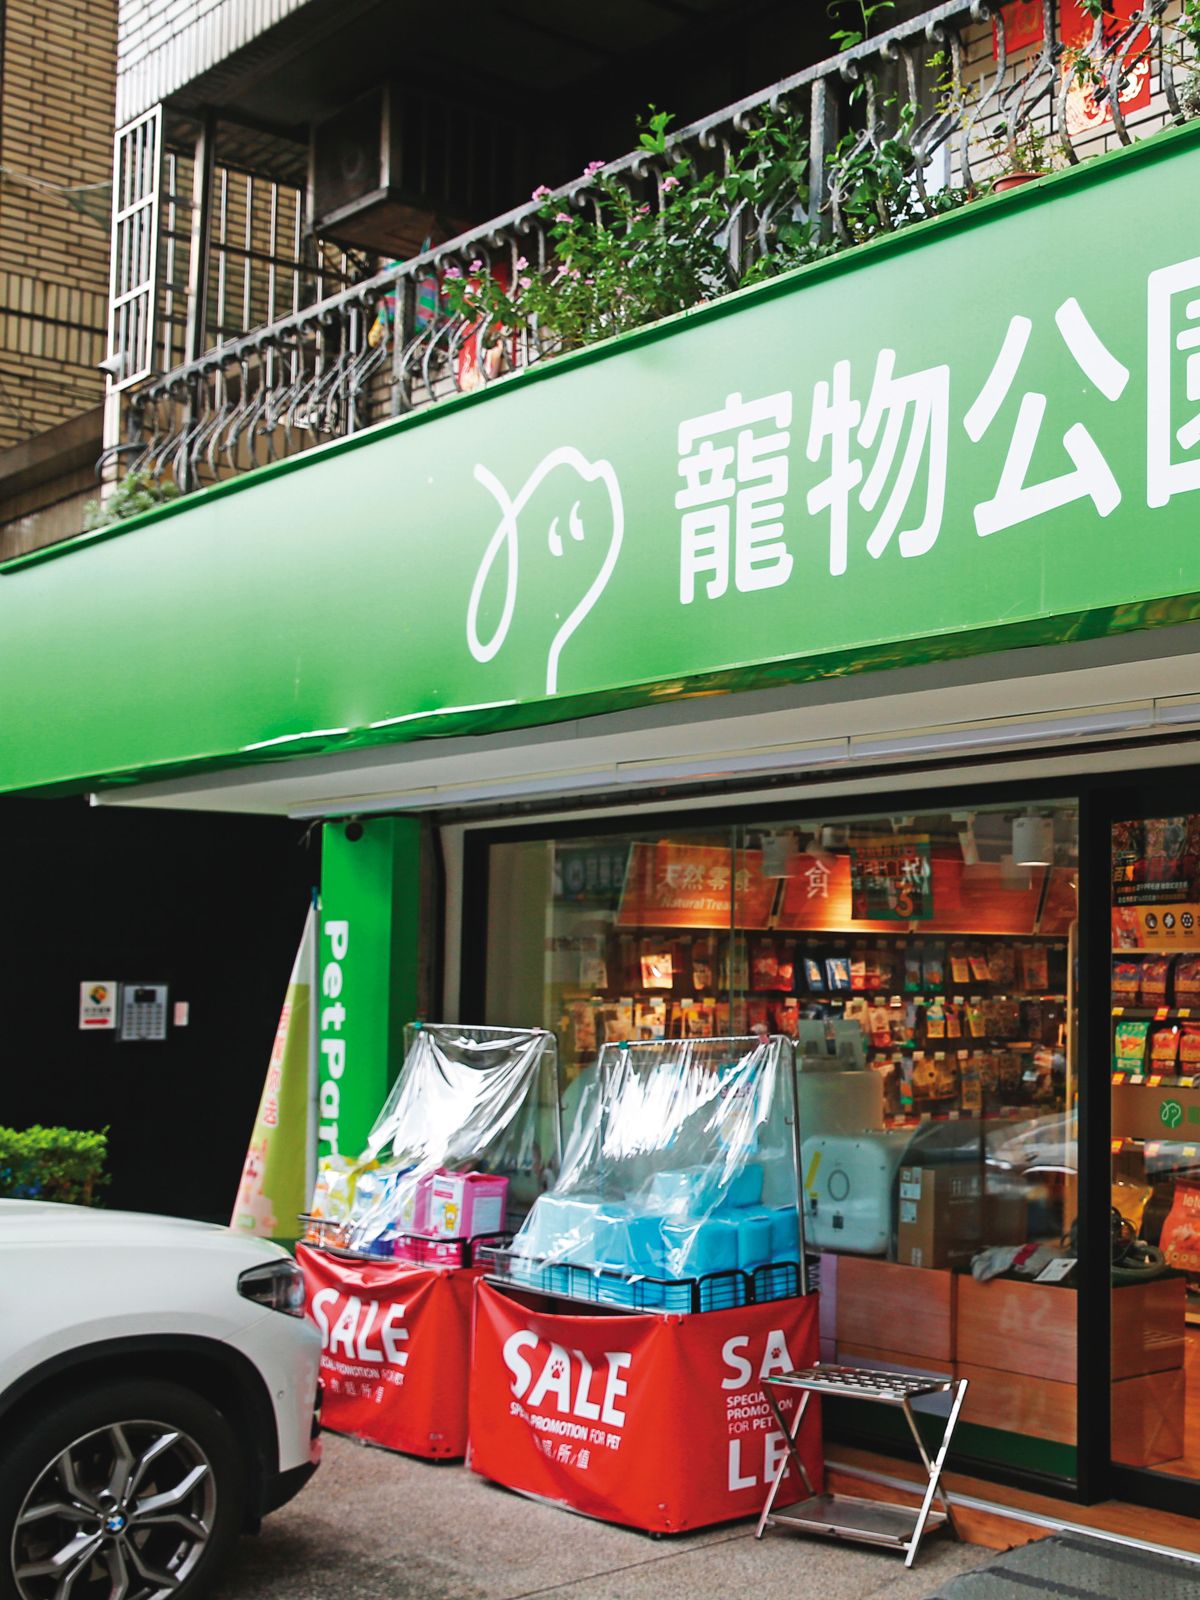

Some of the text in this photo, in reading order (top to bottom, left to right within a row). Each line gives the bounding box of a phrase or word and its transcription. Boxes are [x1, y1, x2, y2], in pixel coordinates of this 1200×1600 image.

[706, 897, 738, 910] Treas
[318, 920, 350, 1158] PetPar
[312, 1287, 410, 1367] SALE
[503, 1329, 632, 1428] SALE
[726, 1391, 767, 1408] SPECIA
[727, 1397, 794, 1421] PROMOON
[530, 1413, 589, 1441] PROMOTION
[589, 1428, 606, 1446] FOR
[606, 1432, 622, 1451] PET
[728, 1415, 774, 1434] FOR PET
